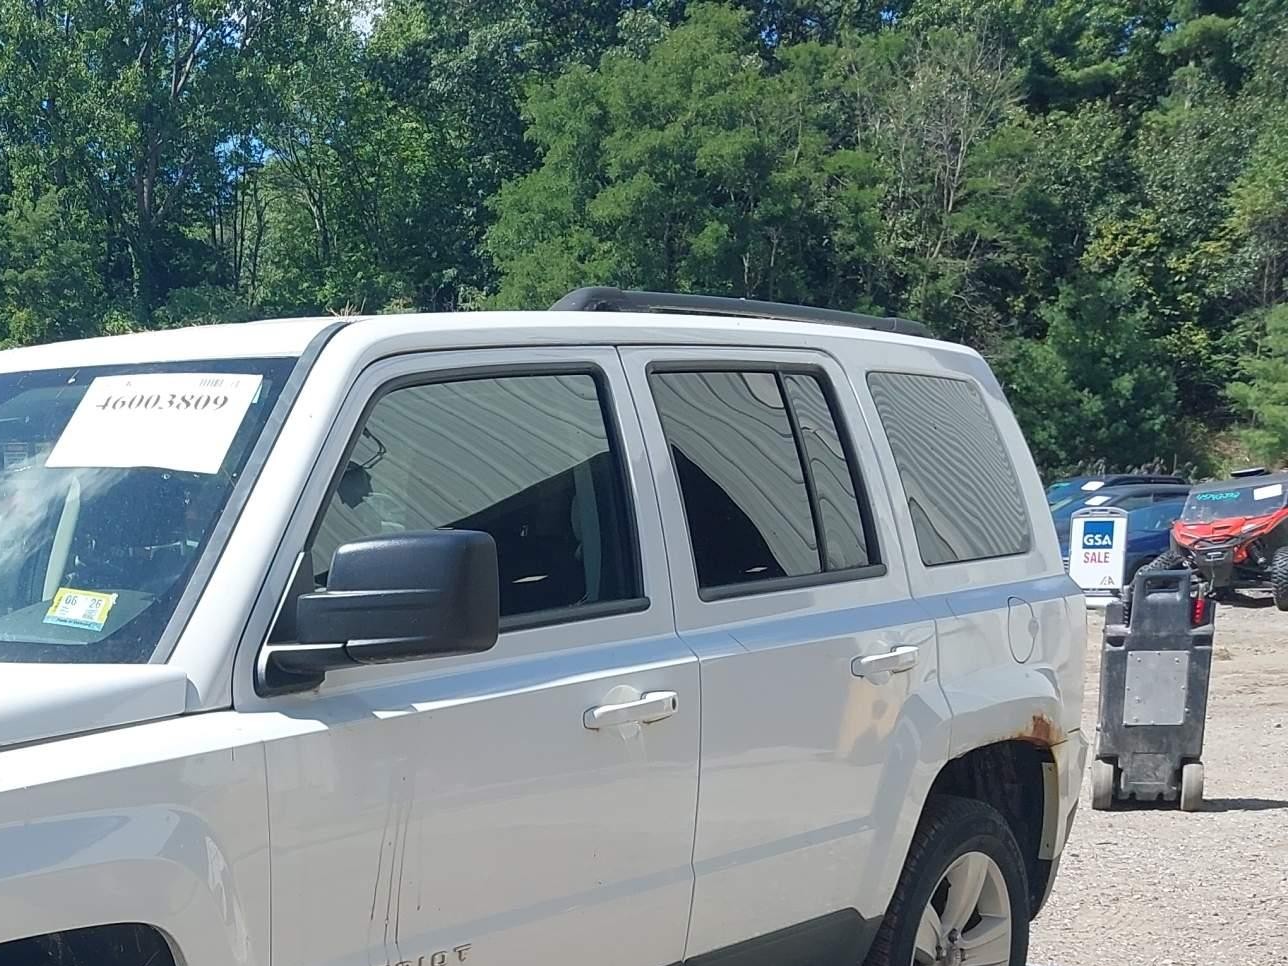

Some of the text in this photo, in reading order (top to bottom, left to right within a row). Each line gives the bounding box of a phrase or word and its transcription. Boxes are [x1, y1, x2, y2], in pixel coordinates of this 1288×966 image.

[95, 393, 229, 410] 46003809
[1083, 533, 1112, 546] GSA
[1083, 551, 1111, 564] SALE
[64, 594, 79, 606] 06
